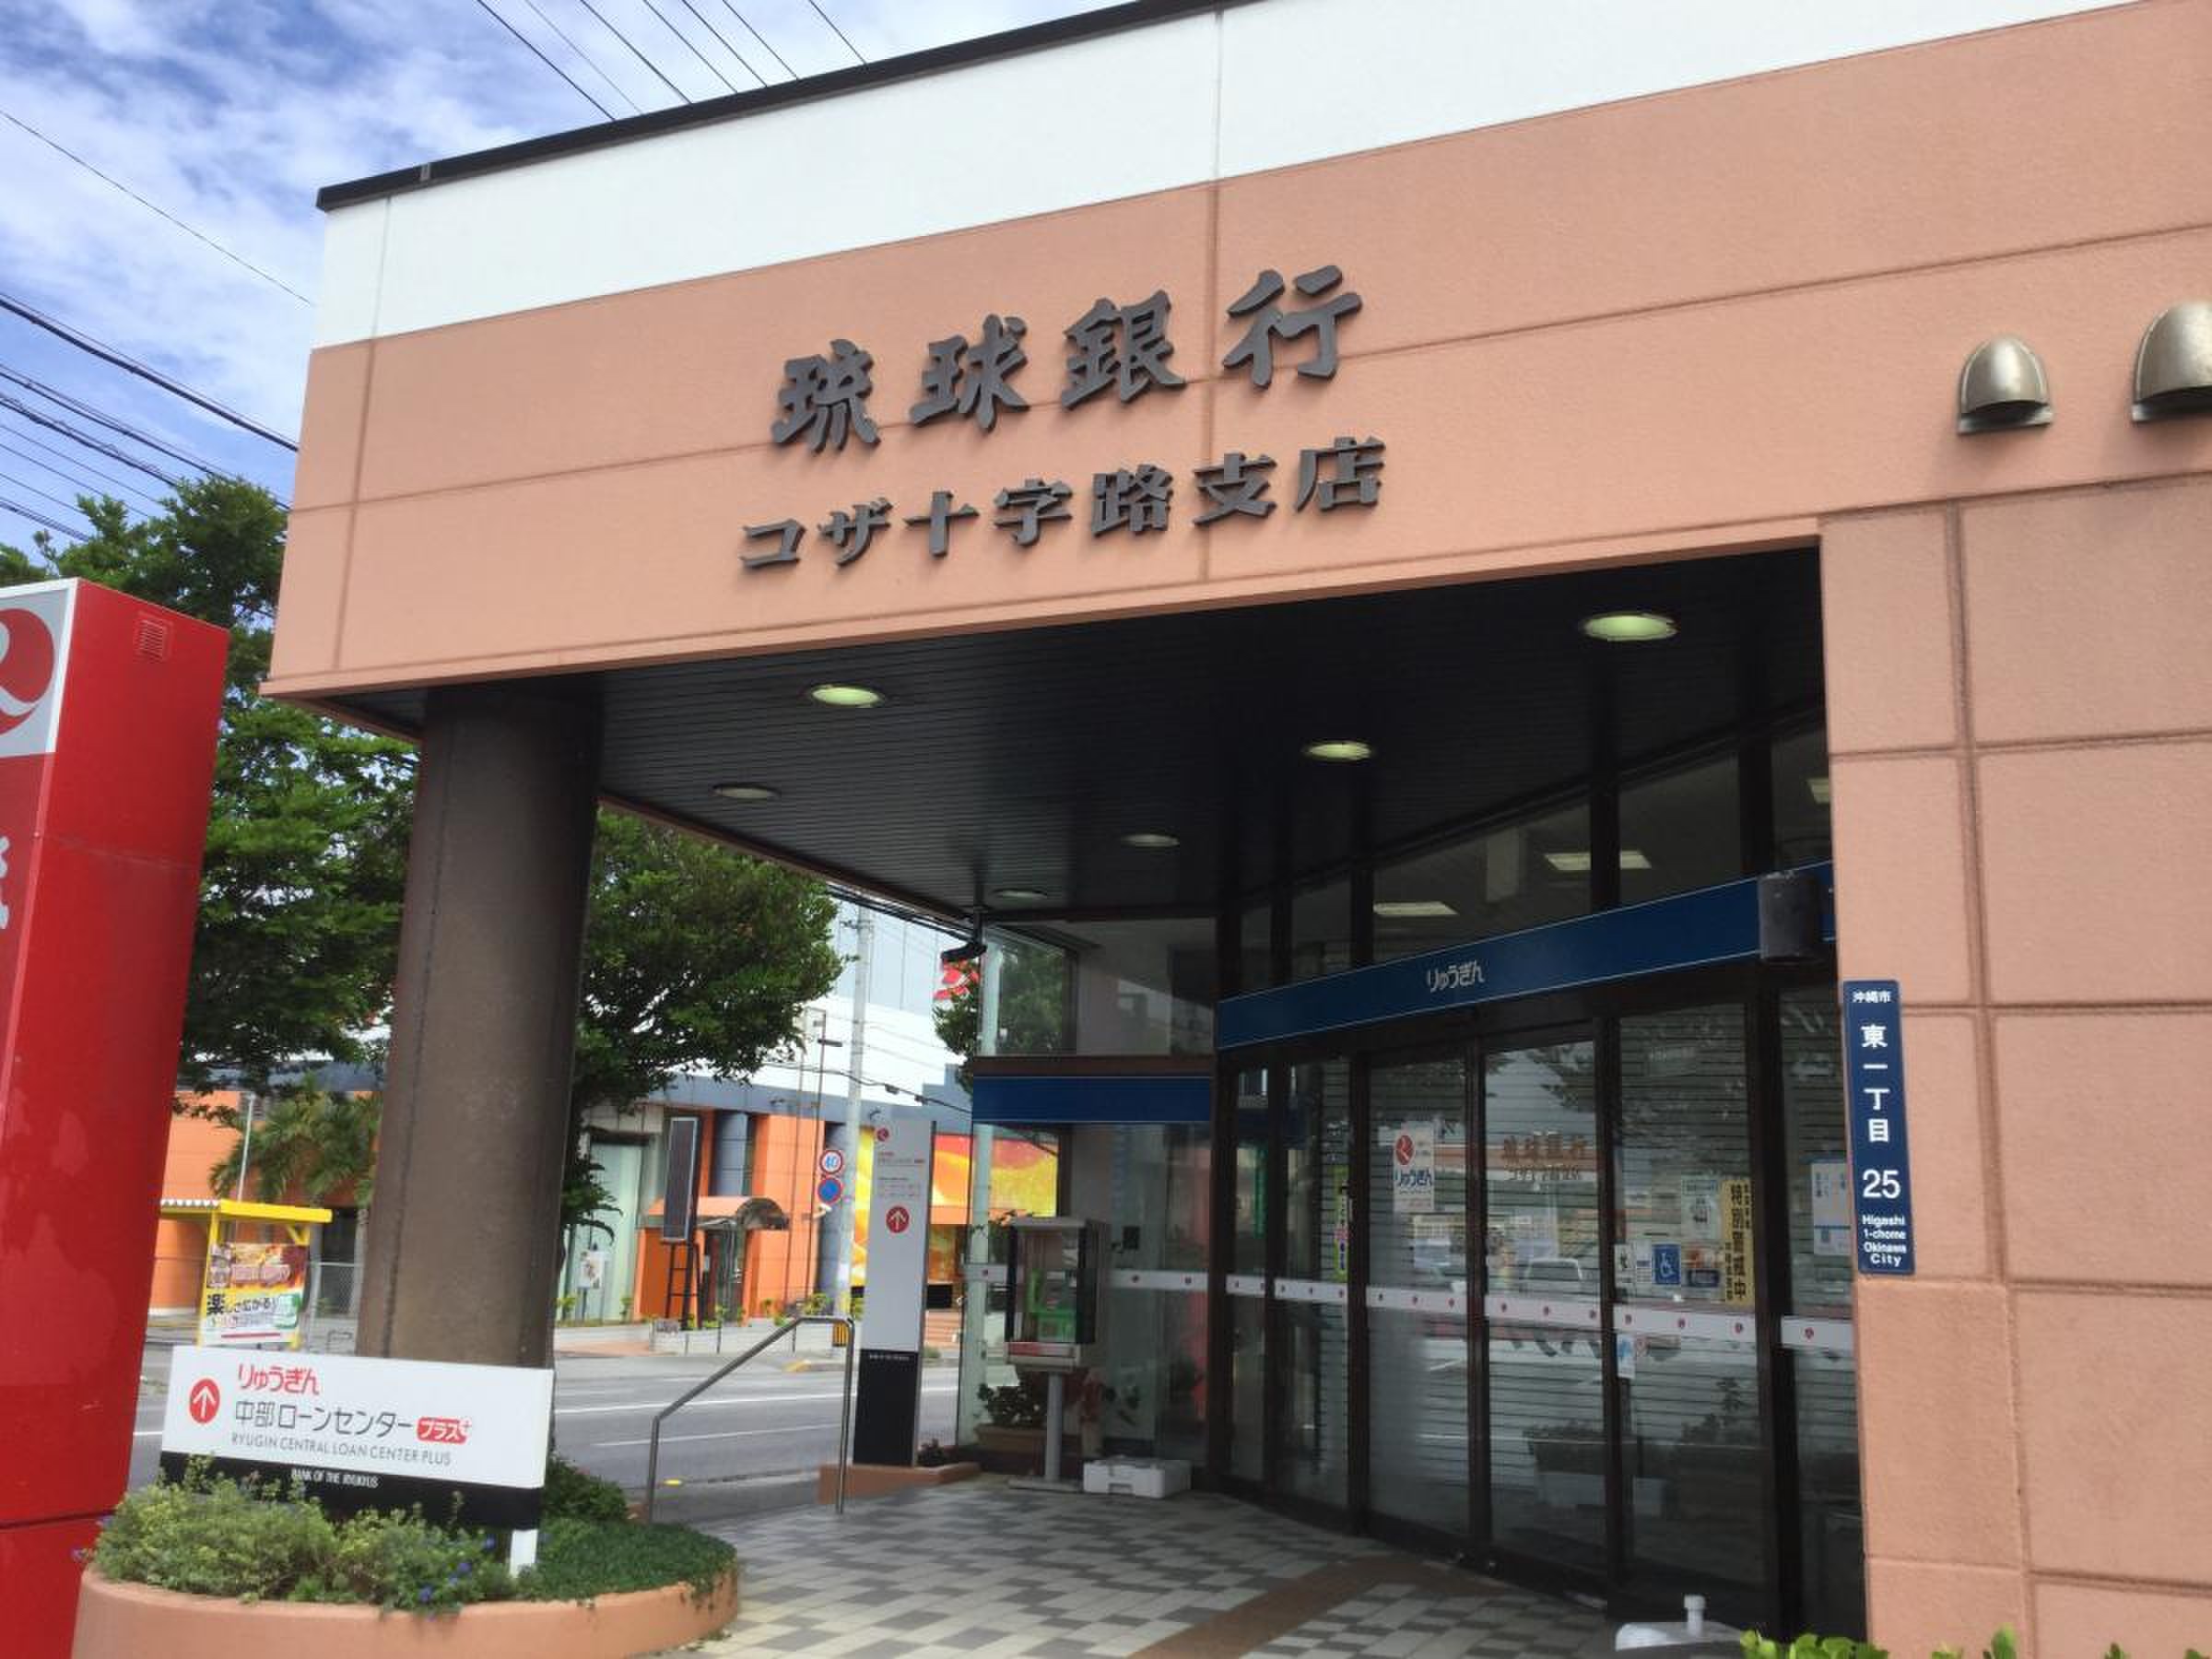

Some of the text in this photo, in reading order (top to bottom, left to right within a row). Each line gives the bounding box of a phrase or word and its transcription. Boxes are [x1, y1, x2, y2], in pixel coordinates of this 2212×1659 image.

[771, 265, 1363, 453] 琉球銀行
[740, 436, 1386, 569] コザ十字路支店
[1427, 959, 1485, 993] りゅうぎん
[1853, 990, 1891, 1004] 沖縄市
[1861, 1024, 1890, 1143] 東一丁目
[1862, 1169, 1901, 1199] 25
[1862, 1214, 1906, 1228] Higashi
[1864, 1229, 1907, 1240] 1-chome
[1864, 1241, 1907, 1253] Okinawa
[1870, 1253, 1902, 1266] City
[237, 1363, 321, 1395] りゅうぎん
[234, 1400, 414, 1439] 中部ローンセンター
[231, 1432, 452, 1466] RYUGIN CENTRAL LOAN CENTER PLUS
